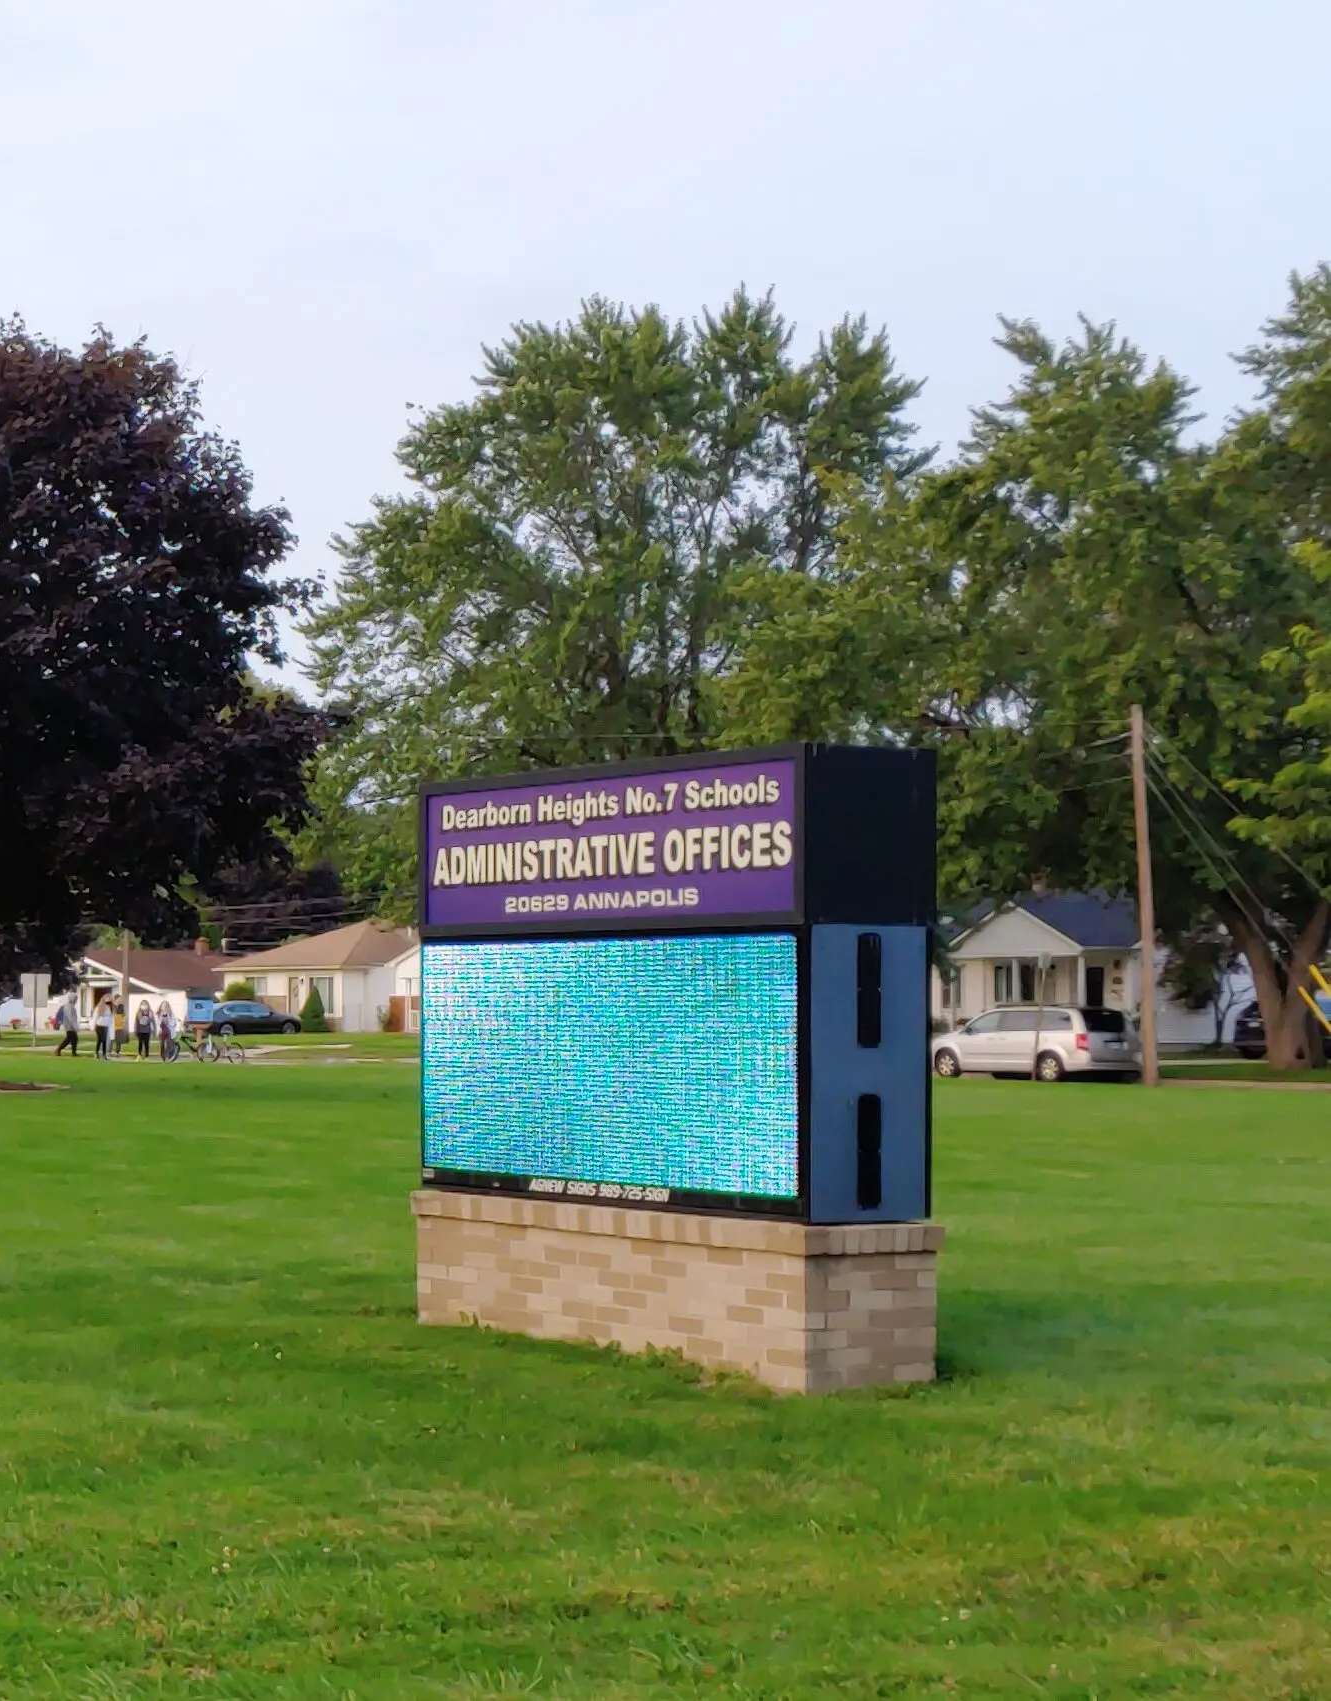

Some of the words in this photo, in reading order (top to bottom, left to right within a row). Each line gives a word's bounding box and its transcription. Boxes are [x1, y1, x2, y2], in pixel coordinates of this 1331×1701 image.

[442, 800, 532, 831] Dearborn
[537, 790, 619, 826] Heights
[684, 774, 780, 810] Schools
[433, 831, 655, 886] ADMINISTRATIVE
[663, 820, 793, 873] OFFICES
[505, 894, 569, 913] 20629
[573, 887, 700, 911] ANNAPOLIS
